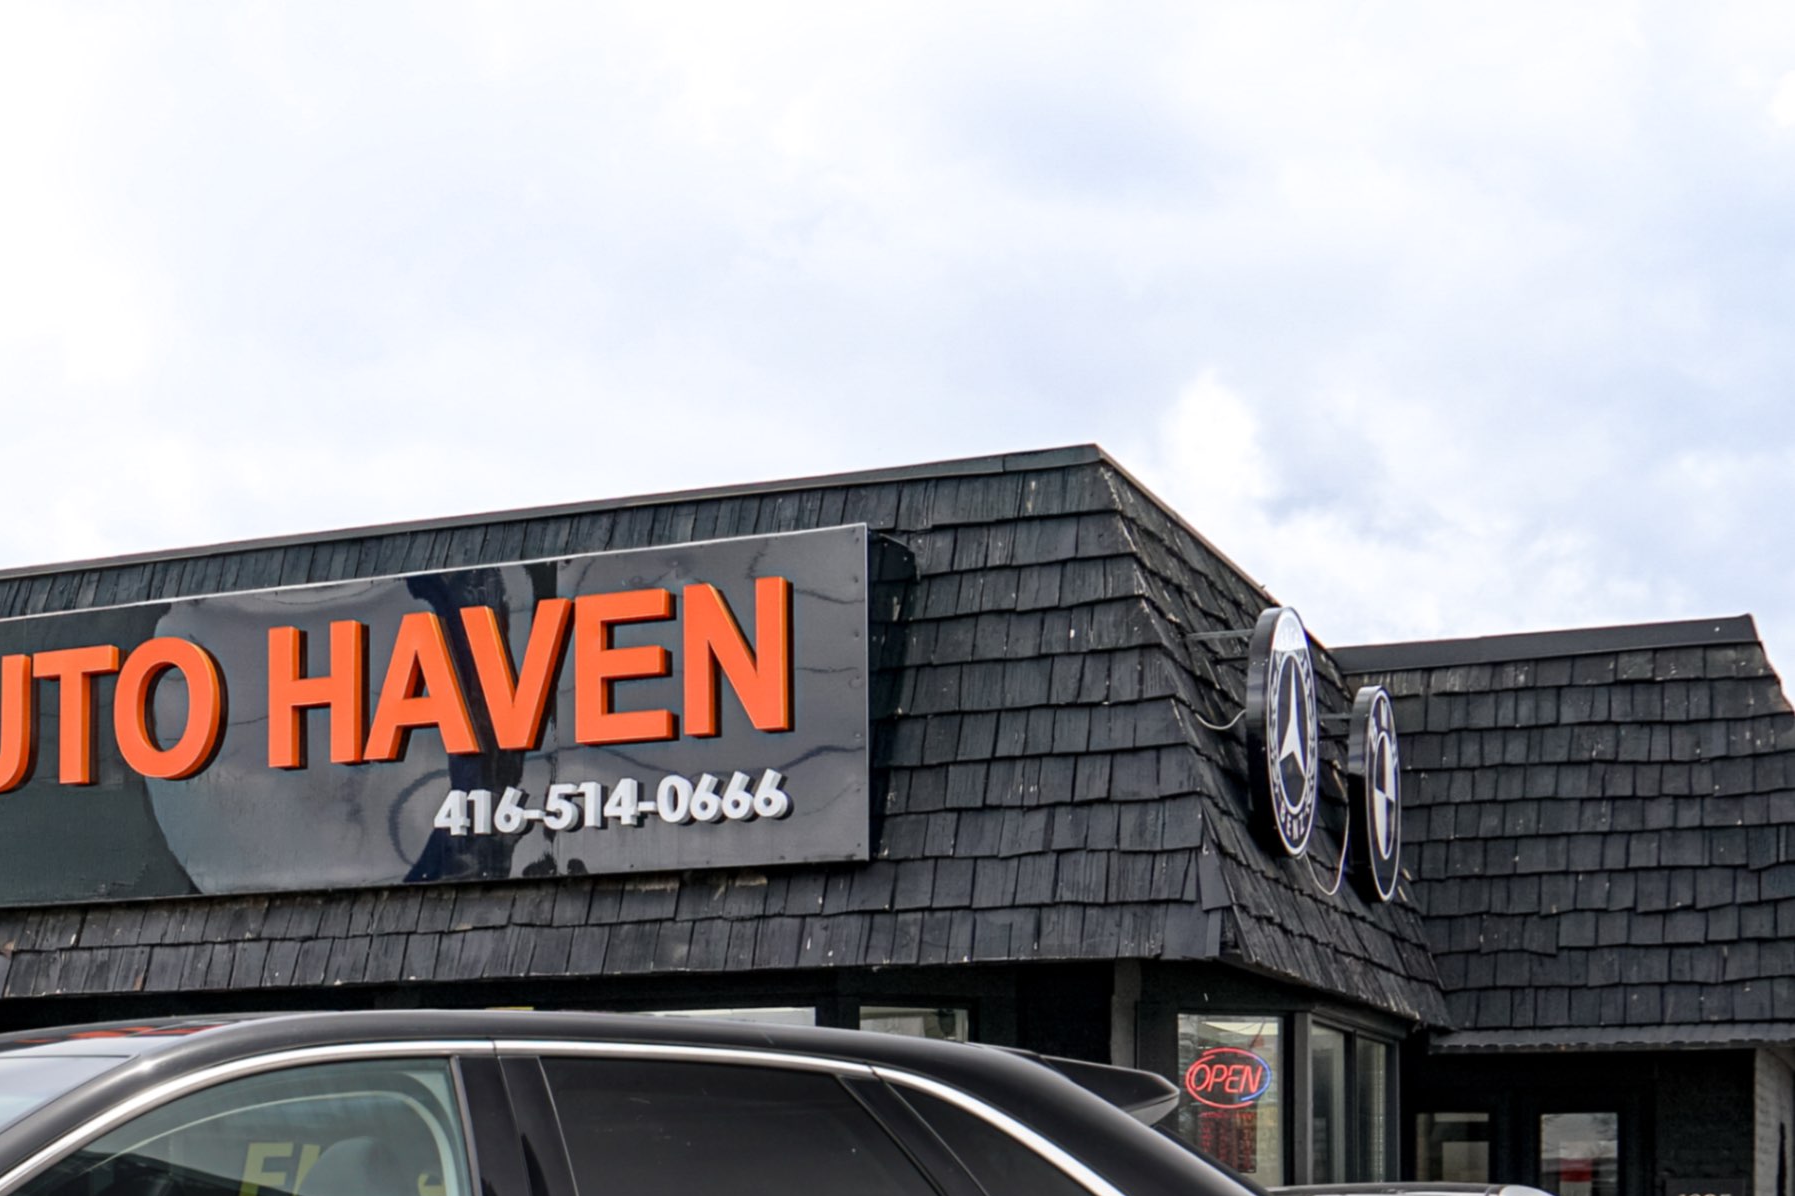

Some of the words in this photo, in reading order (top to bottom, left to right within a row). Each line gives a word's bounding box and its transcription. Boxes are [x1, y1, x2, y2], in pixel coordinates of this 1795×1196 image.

[268, 576, 794, 770] HAVEN
[433, 769, 793, 837] 416-514-0666
[1190, 1063, 1263, 1093] OPEN
